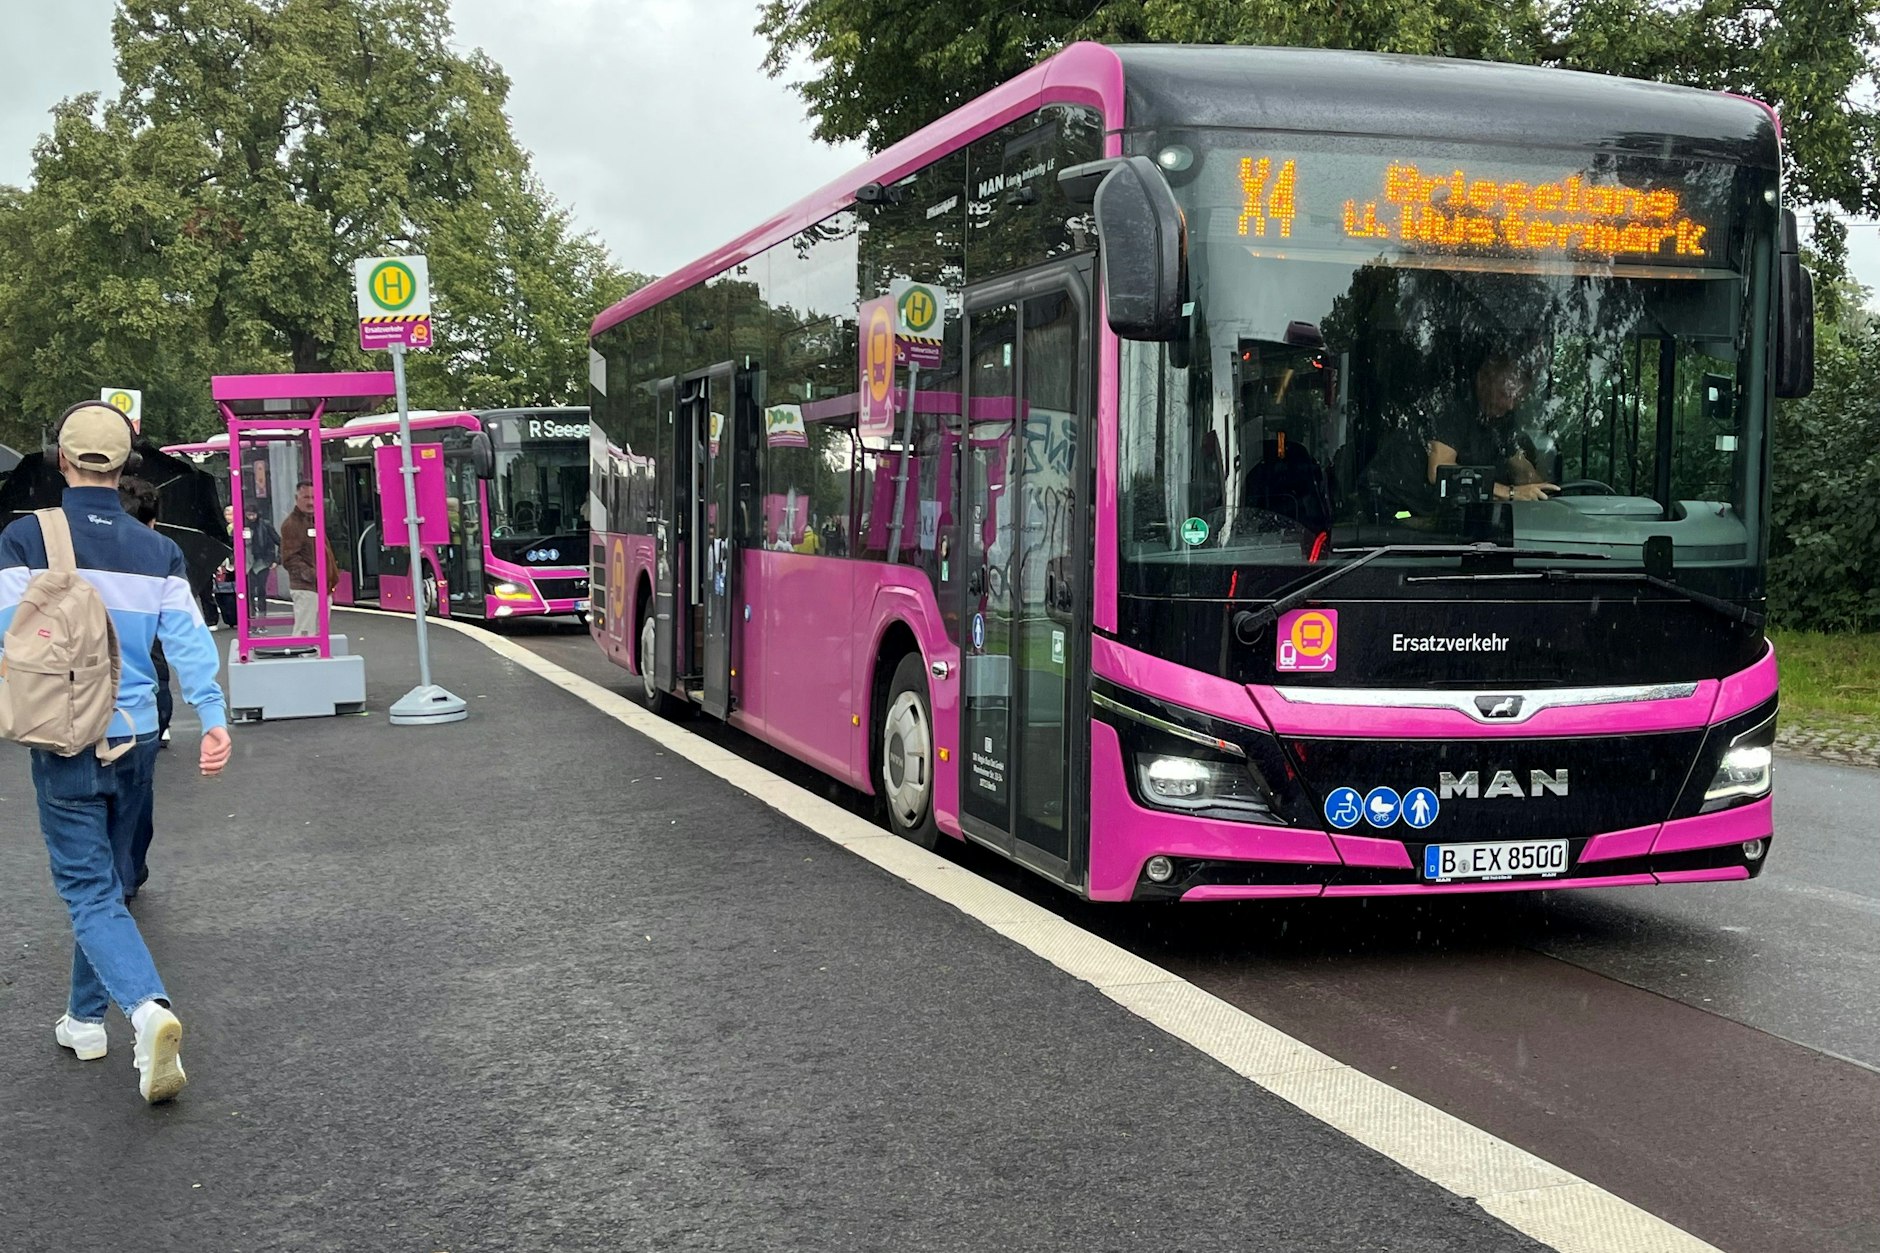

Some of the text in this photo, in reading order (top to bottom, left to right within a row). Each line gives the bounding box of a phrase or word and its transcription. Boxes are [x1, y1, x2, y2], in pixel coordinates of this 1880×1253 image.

[978, 173, 1004, 199] MAN
[1047, 158, 1055, 170] LE
[1385, 163, 1679, 220] Brieselang
[1237, 156, 1296, 238] X4
[1400, 205, 1707, 256] Wustermark
[382, 271, 403, 300] H
[528, 419, 542, 438] R
[1392, 632, 1510, 653] Ersatzverkehr
[1438, 768, 1570, 800] MAN
[1442, 849, 1456, 873] B
[1473, 847, 1502, 872] EX
[1508, 844, 1563, 870] 8500
